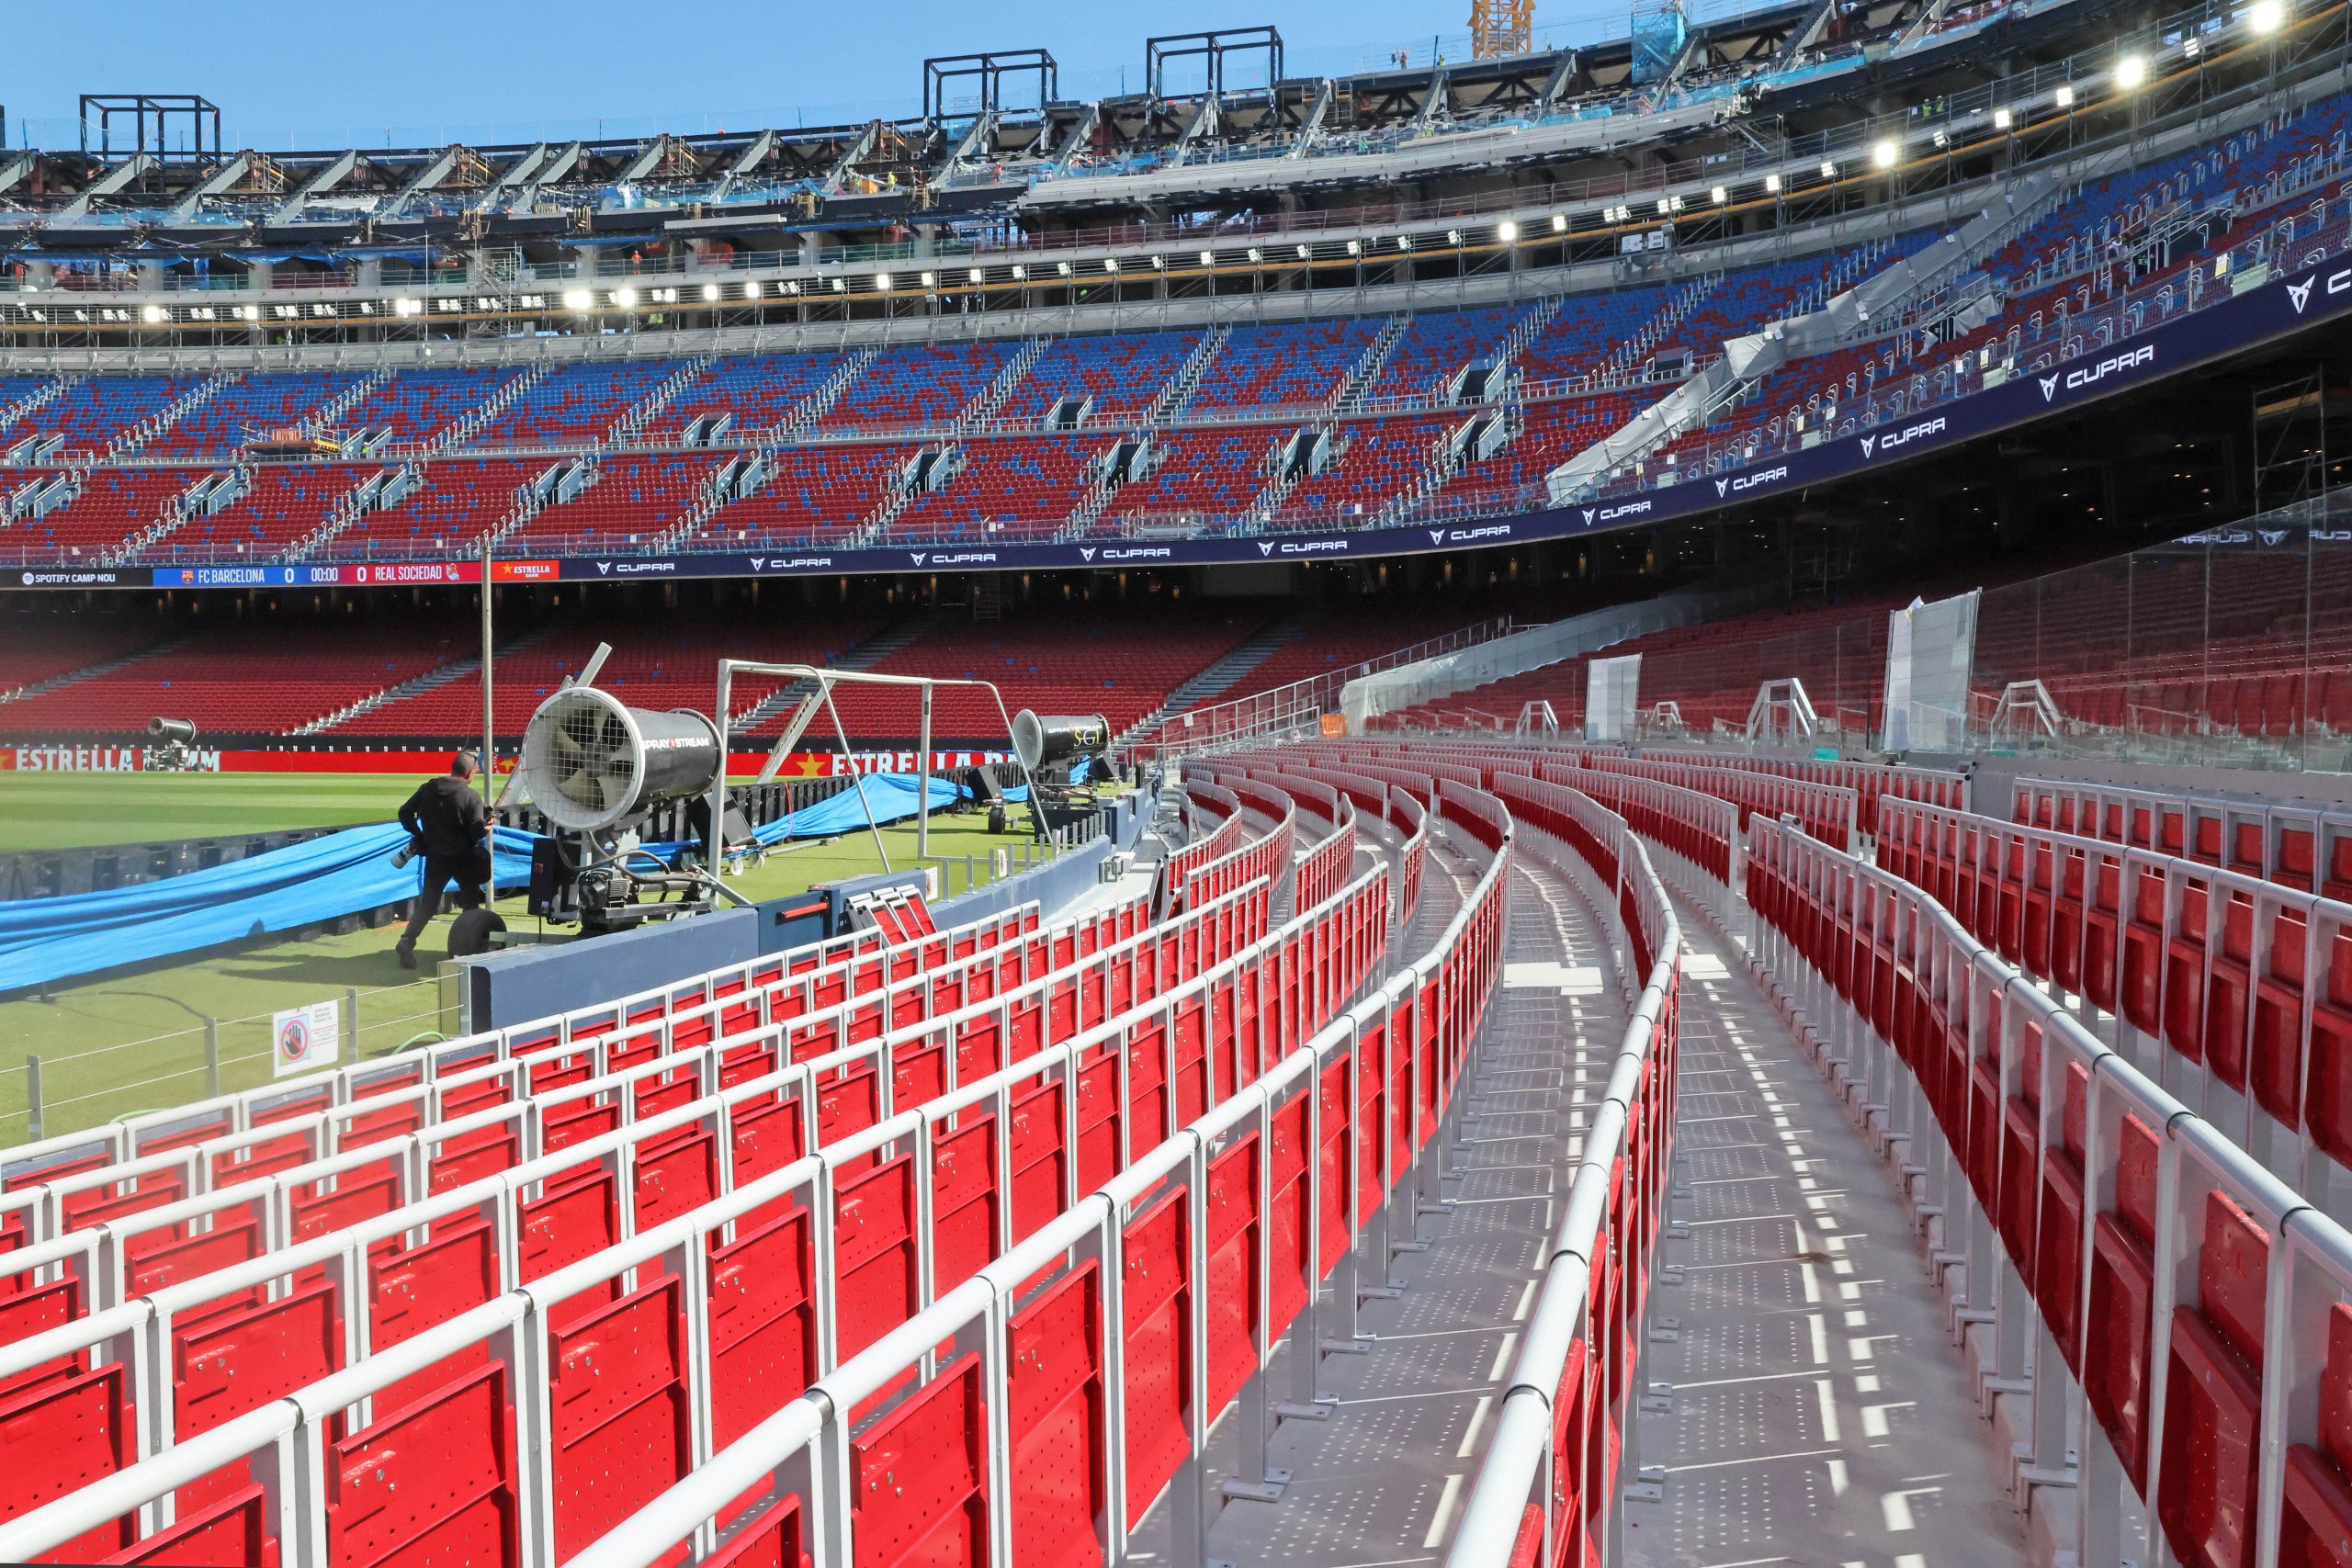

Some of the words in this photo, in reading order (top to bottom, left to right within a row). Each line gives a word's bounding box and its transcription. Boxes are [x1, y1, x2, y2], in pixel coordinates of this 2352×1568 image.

[2066, 344, 2154, 389] CUPRA
[1881, 417, 1946, 449] CUPRA
[1734, 466, 1787, 490] CUPRA
[1600, 501, 1651, 519] CUPRA
[1451, 525, 1510, 540] CUPRA
[1102, 548, 1170, 558] CUPRA
[1282, 540, 1348, 552] CUPRA
[770, 558, 831, 568] CUPRA
[933, 554, 997, 563] CUPRA
[311, 567, 338, 582] 00:00
[356, 567, 367, 582] 0
[375, 567, 396, 581] REAL
[398, 565, 442, 581] SOCIEDAD
[514, 565, 550, 574] ESTRELLA
[616, 562, 675, 572] CUPRA
[35, 574, 70, 583] SPOTIFY
[72, 573, 96, 583] CAMP
[97, 573, 116, 582] NOU
[198, 570, 210, 583] FC
[211, 569, 266, 583] BARCELONA
[285, 568, 295, 583] 0
[675, 737, 710, 748] STREAM
[17, 749, 134, 772] ESTRELLA
